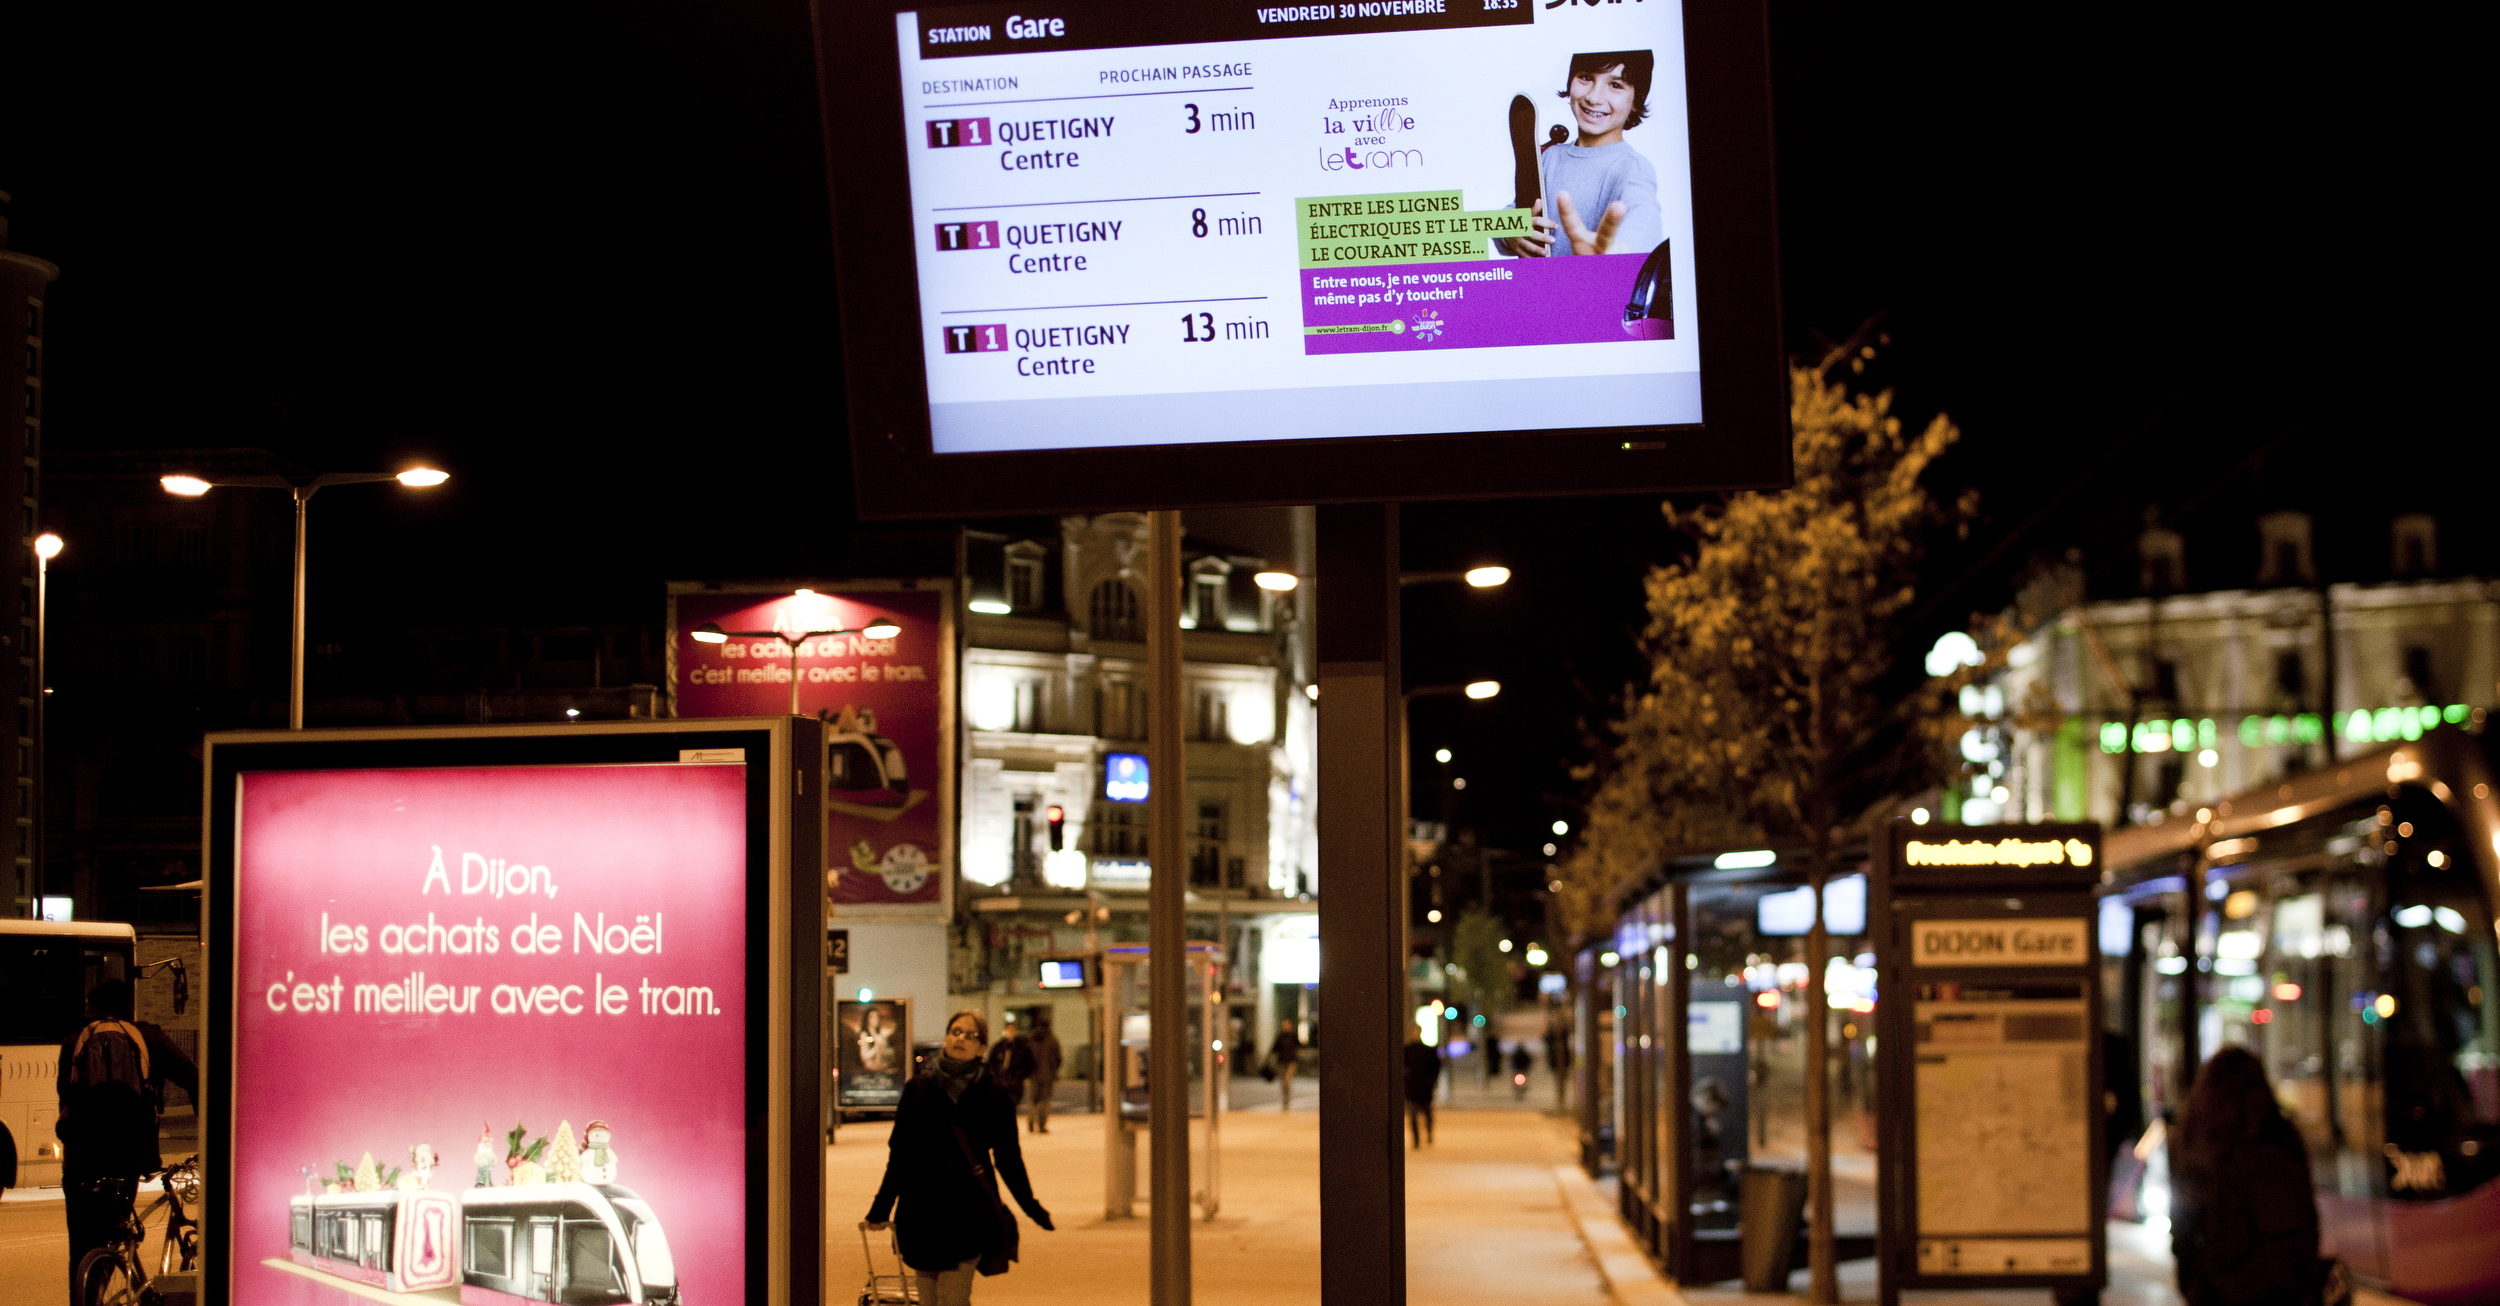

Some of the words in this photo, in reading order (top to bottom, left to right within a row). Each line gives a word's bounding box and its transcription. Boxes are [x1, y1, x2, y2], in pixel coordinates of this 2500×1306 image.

[1257, 4, 1335, 24] VENDREDI
[1339, 4, 1356, 19] 30
[1358, 0, 1446, 18] NOVEMBRE
[928, 25, 991, 44] STATION
[1006, 14, 1065, 39] Gare
[1099, 66, 1177, 85] PROCHAIN
[1182, 62, 1252, 80] PASSAGE
[922, 77, 1018, 95] DESTINATION
[1328, 96, 1409, 112] Apprenons
[998, 116, 1116, 143] QUETIGNY
[1184, 103, 1201, 134] 3
[1211, 106, 1256, 132] min
[1323, 117, 1345, 134] la
[1354, 136, 1386, 146] avec
[1000, 150, 1080, 171] Centre
[1308, 202, 1363, 218] ENTRE
[1367, 199, 1395, 215] LES
[1399, 196, 1460, 213] LIGNES
[1006, 220, 1123, 249] QUETIGNY
[1191, 208, 1208, 238] 8
[1218, 211, 1262, 237] min
[1310, 221, 1421, 240] ÉLECTRIQUES
[1425, 219, 1445, 234] ET
[1449, 218, 1468, 233] LE
[1472, 215, 1529, 232] TRAM,
[1312, 248, 1329, 262] LE
[1334, 243, 1418, 261] COURANT
[1422, 240, 1485, 257] PASSE...
[1008, 253, 1088, 274] Centre
[1312, 275, 1347, 289] Entre
[1350, 274, 1386, 289] nous,
[1387, 272, 1401, 289] je
[1403, 274, 1420, 286] ne
[1422, 272, 1453, 285] vous
[1455, 267, 1513, 284] conseille
[1314, 290, 1355, 306] même
[1358, 292, 1381, 307] pas
[1015, 324, 1131, 352] QUETIGNY
[1181, 312, 1216, 343] 13
[1226, 315, 1270, 340] min
[1316, 324, 1388, 334] www.letram-dijon.fr
[1017, 356, 1096, 377] Centre
[817, 636, 847, 658] de
[807, 666, 858, 684] avec
[861, 660, 880, 682] le
[422, 845, 451, 895] À
[461, 852, 559, 900] Dijon,
[320, 911, 369, 955] les
[379, 912, 500, 955] achats
[510, 912, 562, 954] de
[573, 911, 662, 955] Noël
[2013, 929, 2077, 954] Gare
[266, 970, 345, 1014] c'est
[353, 971, 480, 1015] meilleur
[490, 980, 584, 1016] avec
[595, 972, 629, 1015] le
[639, 976, 721, 1015] tram.
